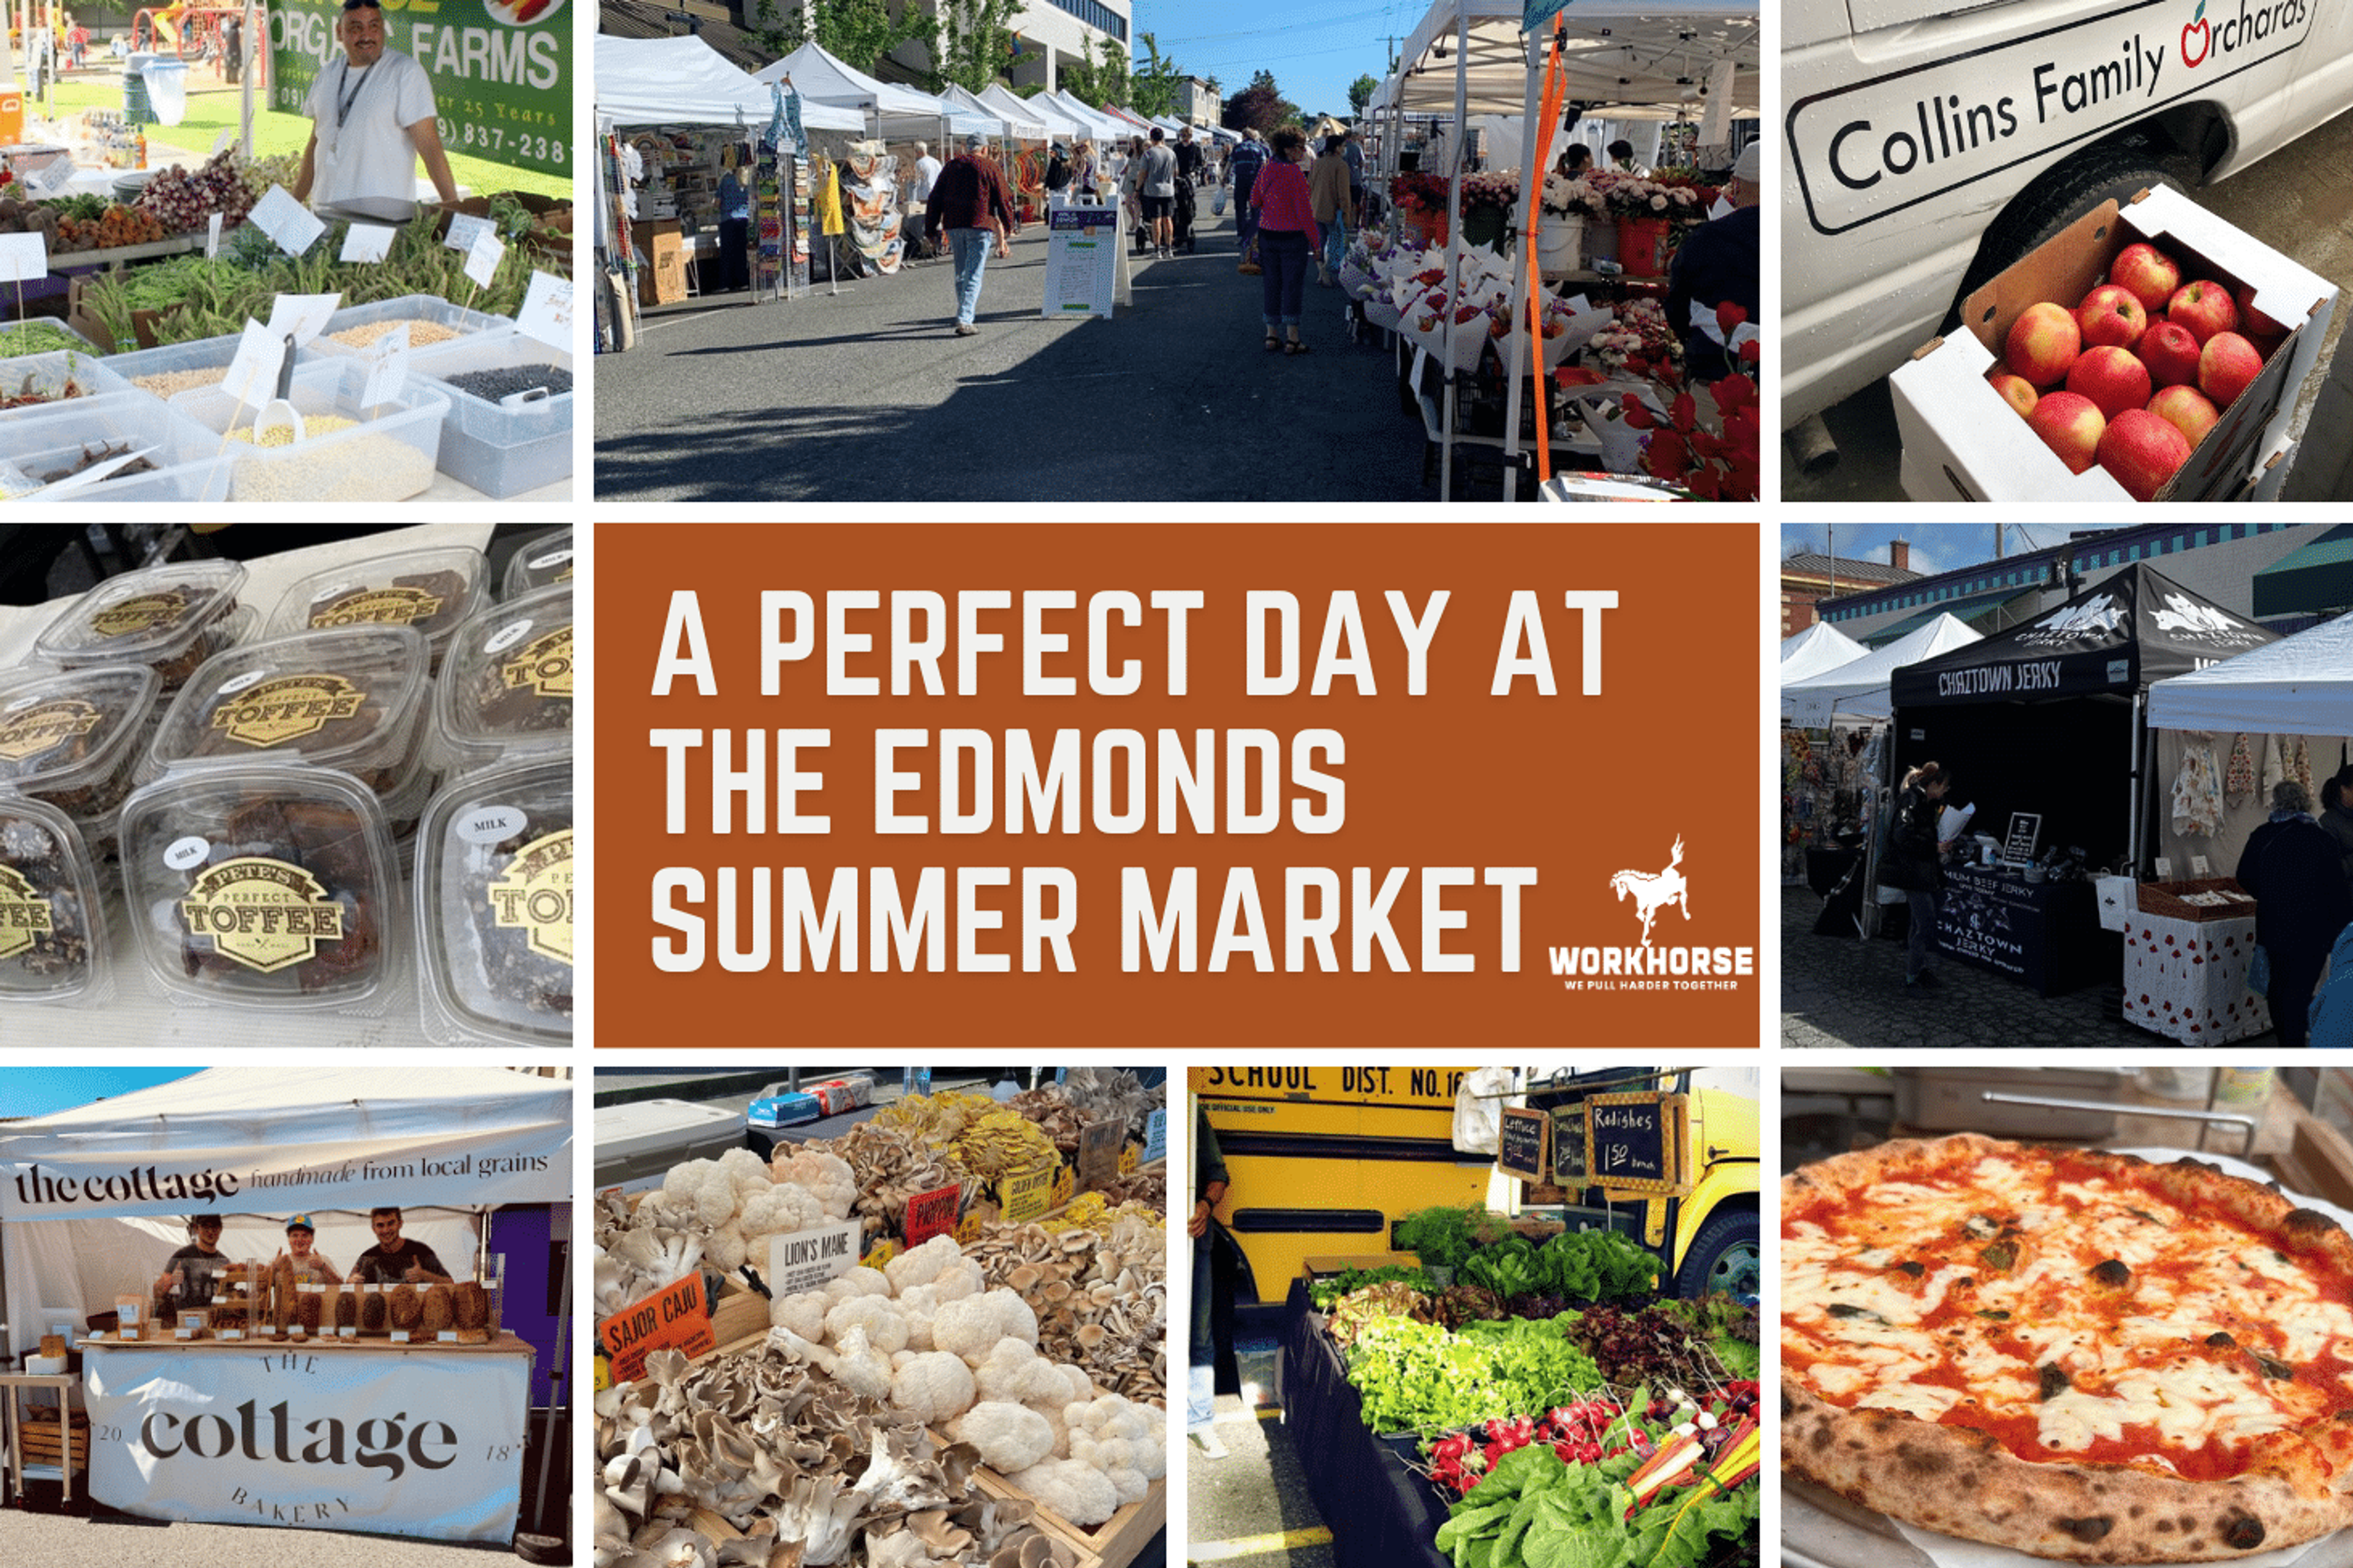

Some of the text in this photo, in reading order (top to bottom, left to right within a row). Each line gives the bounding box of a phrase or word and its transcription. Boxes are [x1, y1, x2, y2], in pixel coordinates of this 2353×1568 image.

[412, 22, 559, 89] FARMS
[1828, 0, 2306, 189] Collins Family Orchards
[494, 104, 555, 125] Years
[464, 122, 574, 164] 837-238
[2015, 630, 2109, 642] CHAZTOWN
[506, 657, 573, 685] TO
[1939, 661, 2062, 696] CHAZTOWN JERKY
[216, 697, 355, 728] TOFFEE
[0, 717, 97, 744] OFFEE
[474, 818, 507, 831] MILK
[175, 846, 197, 860] MILK
[216, 864, 290, 886] PETE'S
[224, 892, 290, 903] PERFECT
[2002, 883, 2034, 898] JERKY
[186, 905, 338, 934] TOFFEE
[493, 889, 573, 924] TO
[1956, 937, 1995, 956] JERKY
[1208, 1067, 1316, 1089] SCHOOL
[1343, 1067, 1394, 1094] DIST.
[1411, 1069, 1441, 1097] NO.
[1505, 1118, 1537, 1135] Lettuce
[1595, 1108, 1652, 1130] Radishes
[15, 1151, 548, 1205] the cottage handmade from local grains
[784, 1232, 849, 1267] LION'S MANE
[609, 1306, 659, 1353] SAJOR
[662, 1284, 697, 1324] CAJU
[259, 1353, 319, 1374] THE
[99, 1425, 122, 1442] 20
[141, 1398, 459, 1482] cottage
[487, 1445, 509, 1462] 18
[232, 1486, 350, 1523] BAKERY
